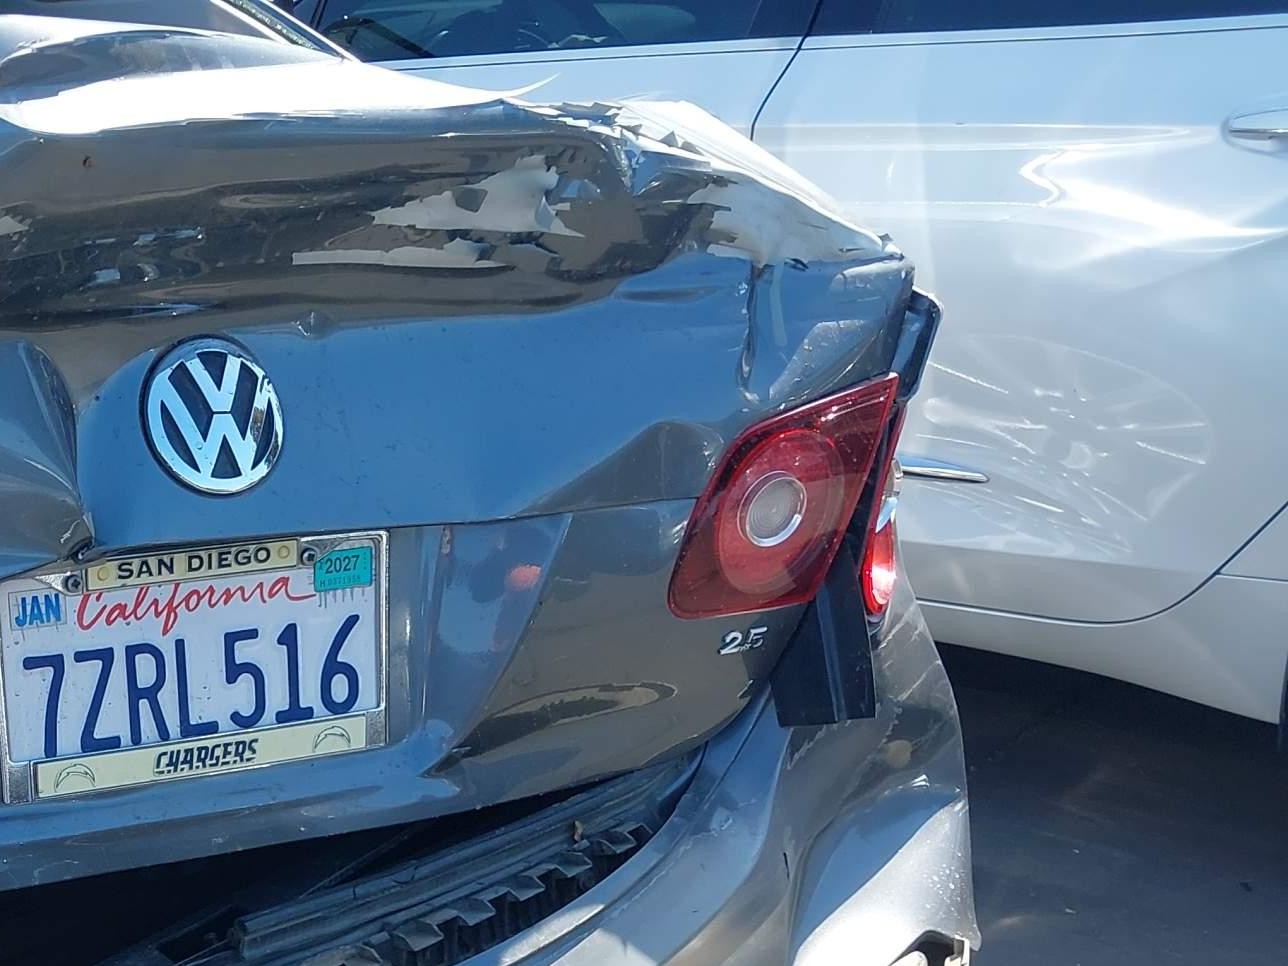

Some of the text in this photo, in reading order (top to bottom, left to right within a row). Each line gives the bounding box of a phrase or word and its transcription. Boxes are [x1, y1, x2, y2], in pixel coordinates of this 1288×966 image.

[116, 546, 272, 580] SAN DIEGO
[324, 554, 360, 575] 2027
[14, 592, 62, 628] JAN
[76, 575, 317, 636] California
[22, 613, 361, 759] 7ZRL516
[154, 738, 260, 776] CHARGERS
